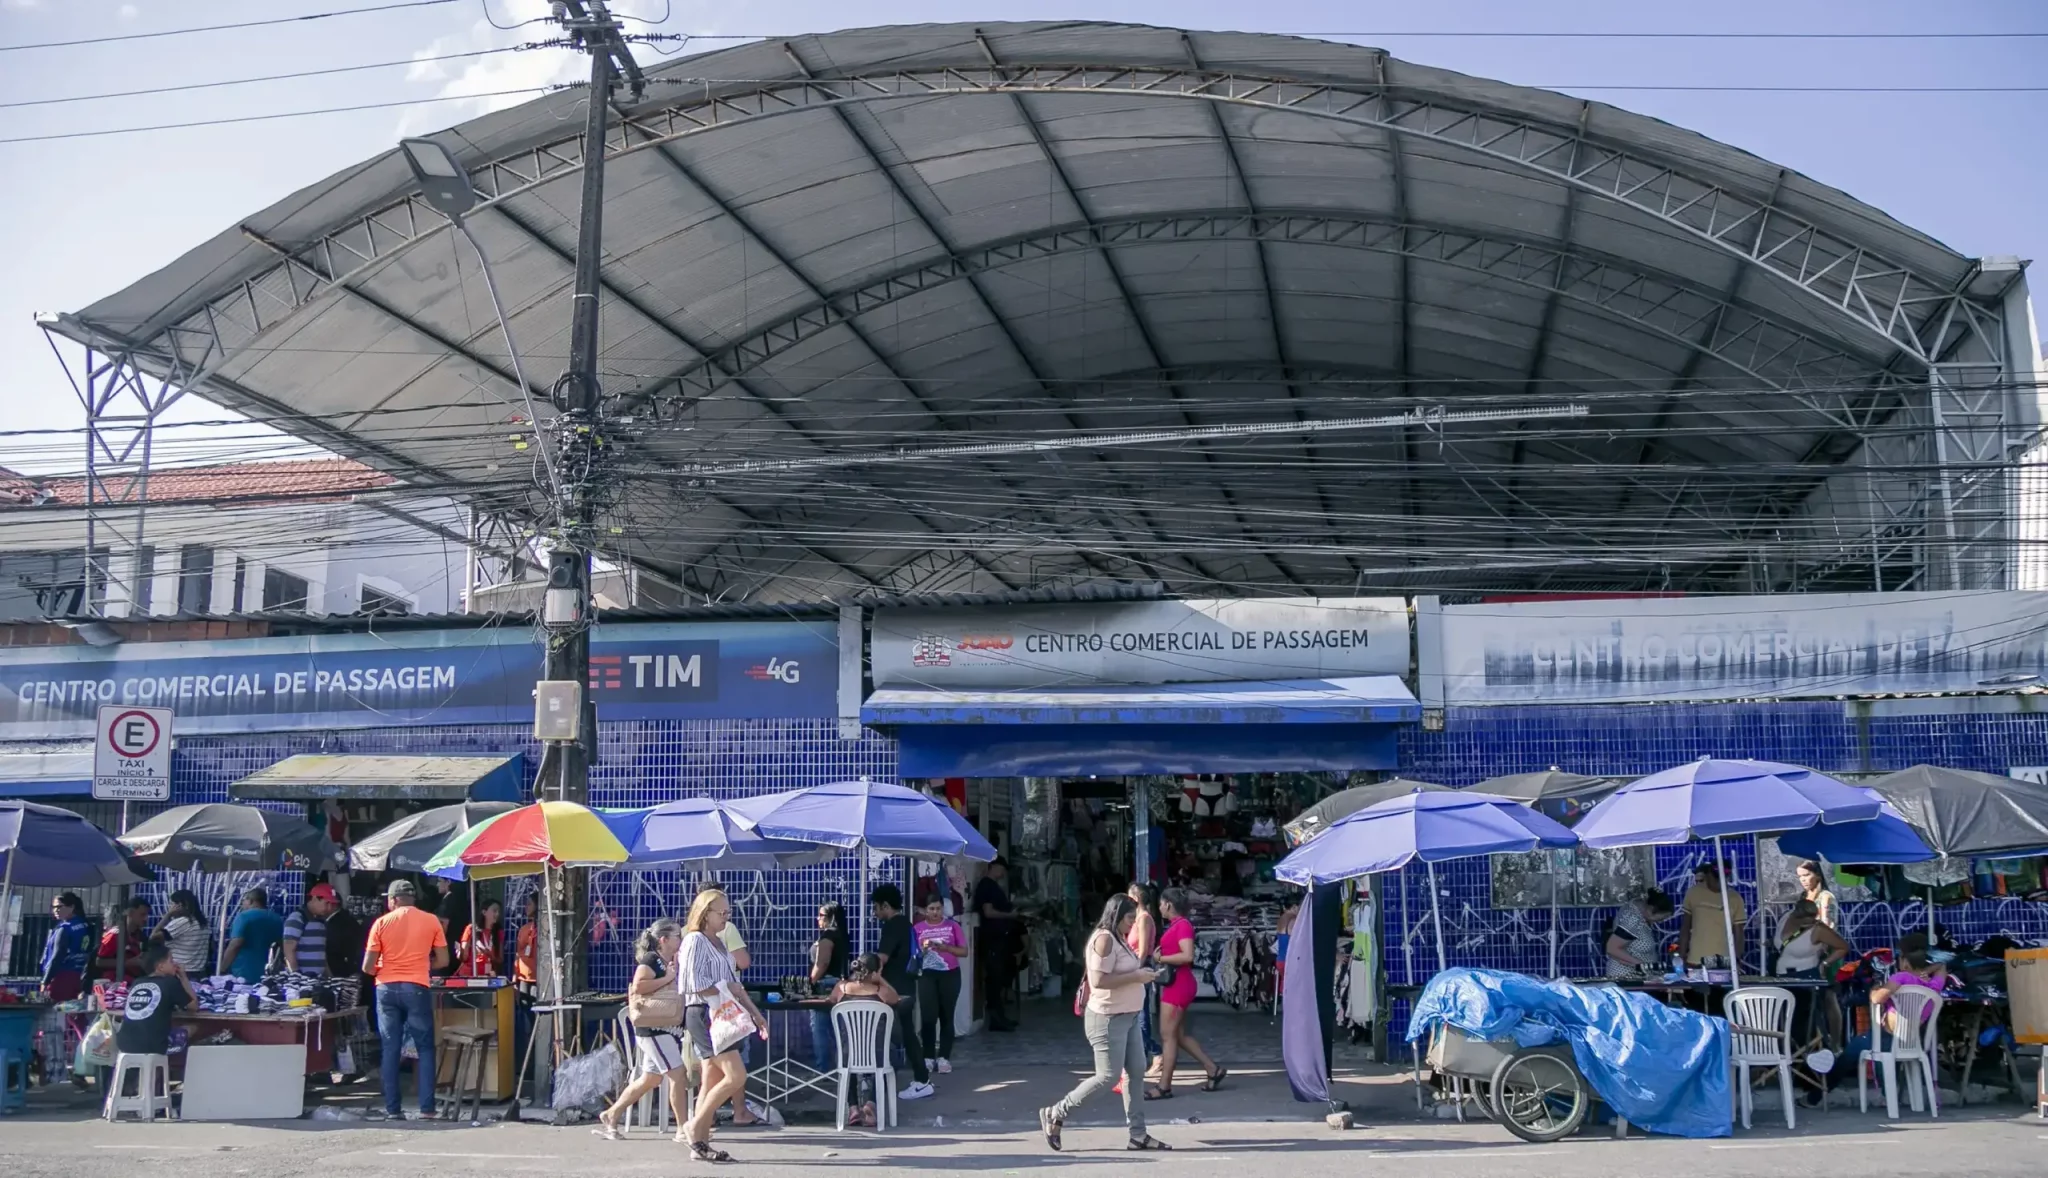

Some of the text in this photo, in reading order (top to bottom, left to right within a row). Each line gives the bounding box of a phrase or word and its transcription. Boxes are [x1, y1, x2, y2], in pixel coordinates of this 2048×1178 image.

[1025, 629, 1368, 652] CENTRO COMERCIAL DE PASSAGEM
[1877, 628, 1919, 658] DE
[628, 655, 700, 688] TIM
[765, 657, 800, 684] 4G
[19, 666, 456, 702] CENTRO COMERCIAL DE PASSAGEM
[125, 722, 145, 747] E
[97, 778, 166, 788] CARGA E DESCARGA
[293, 854, 311, 868] elo
